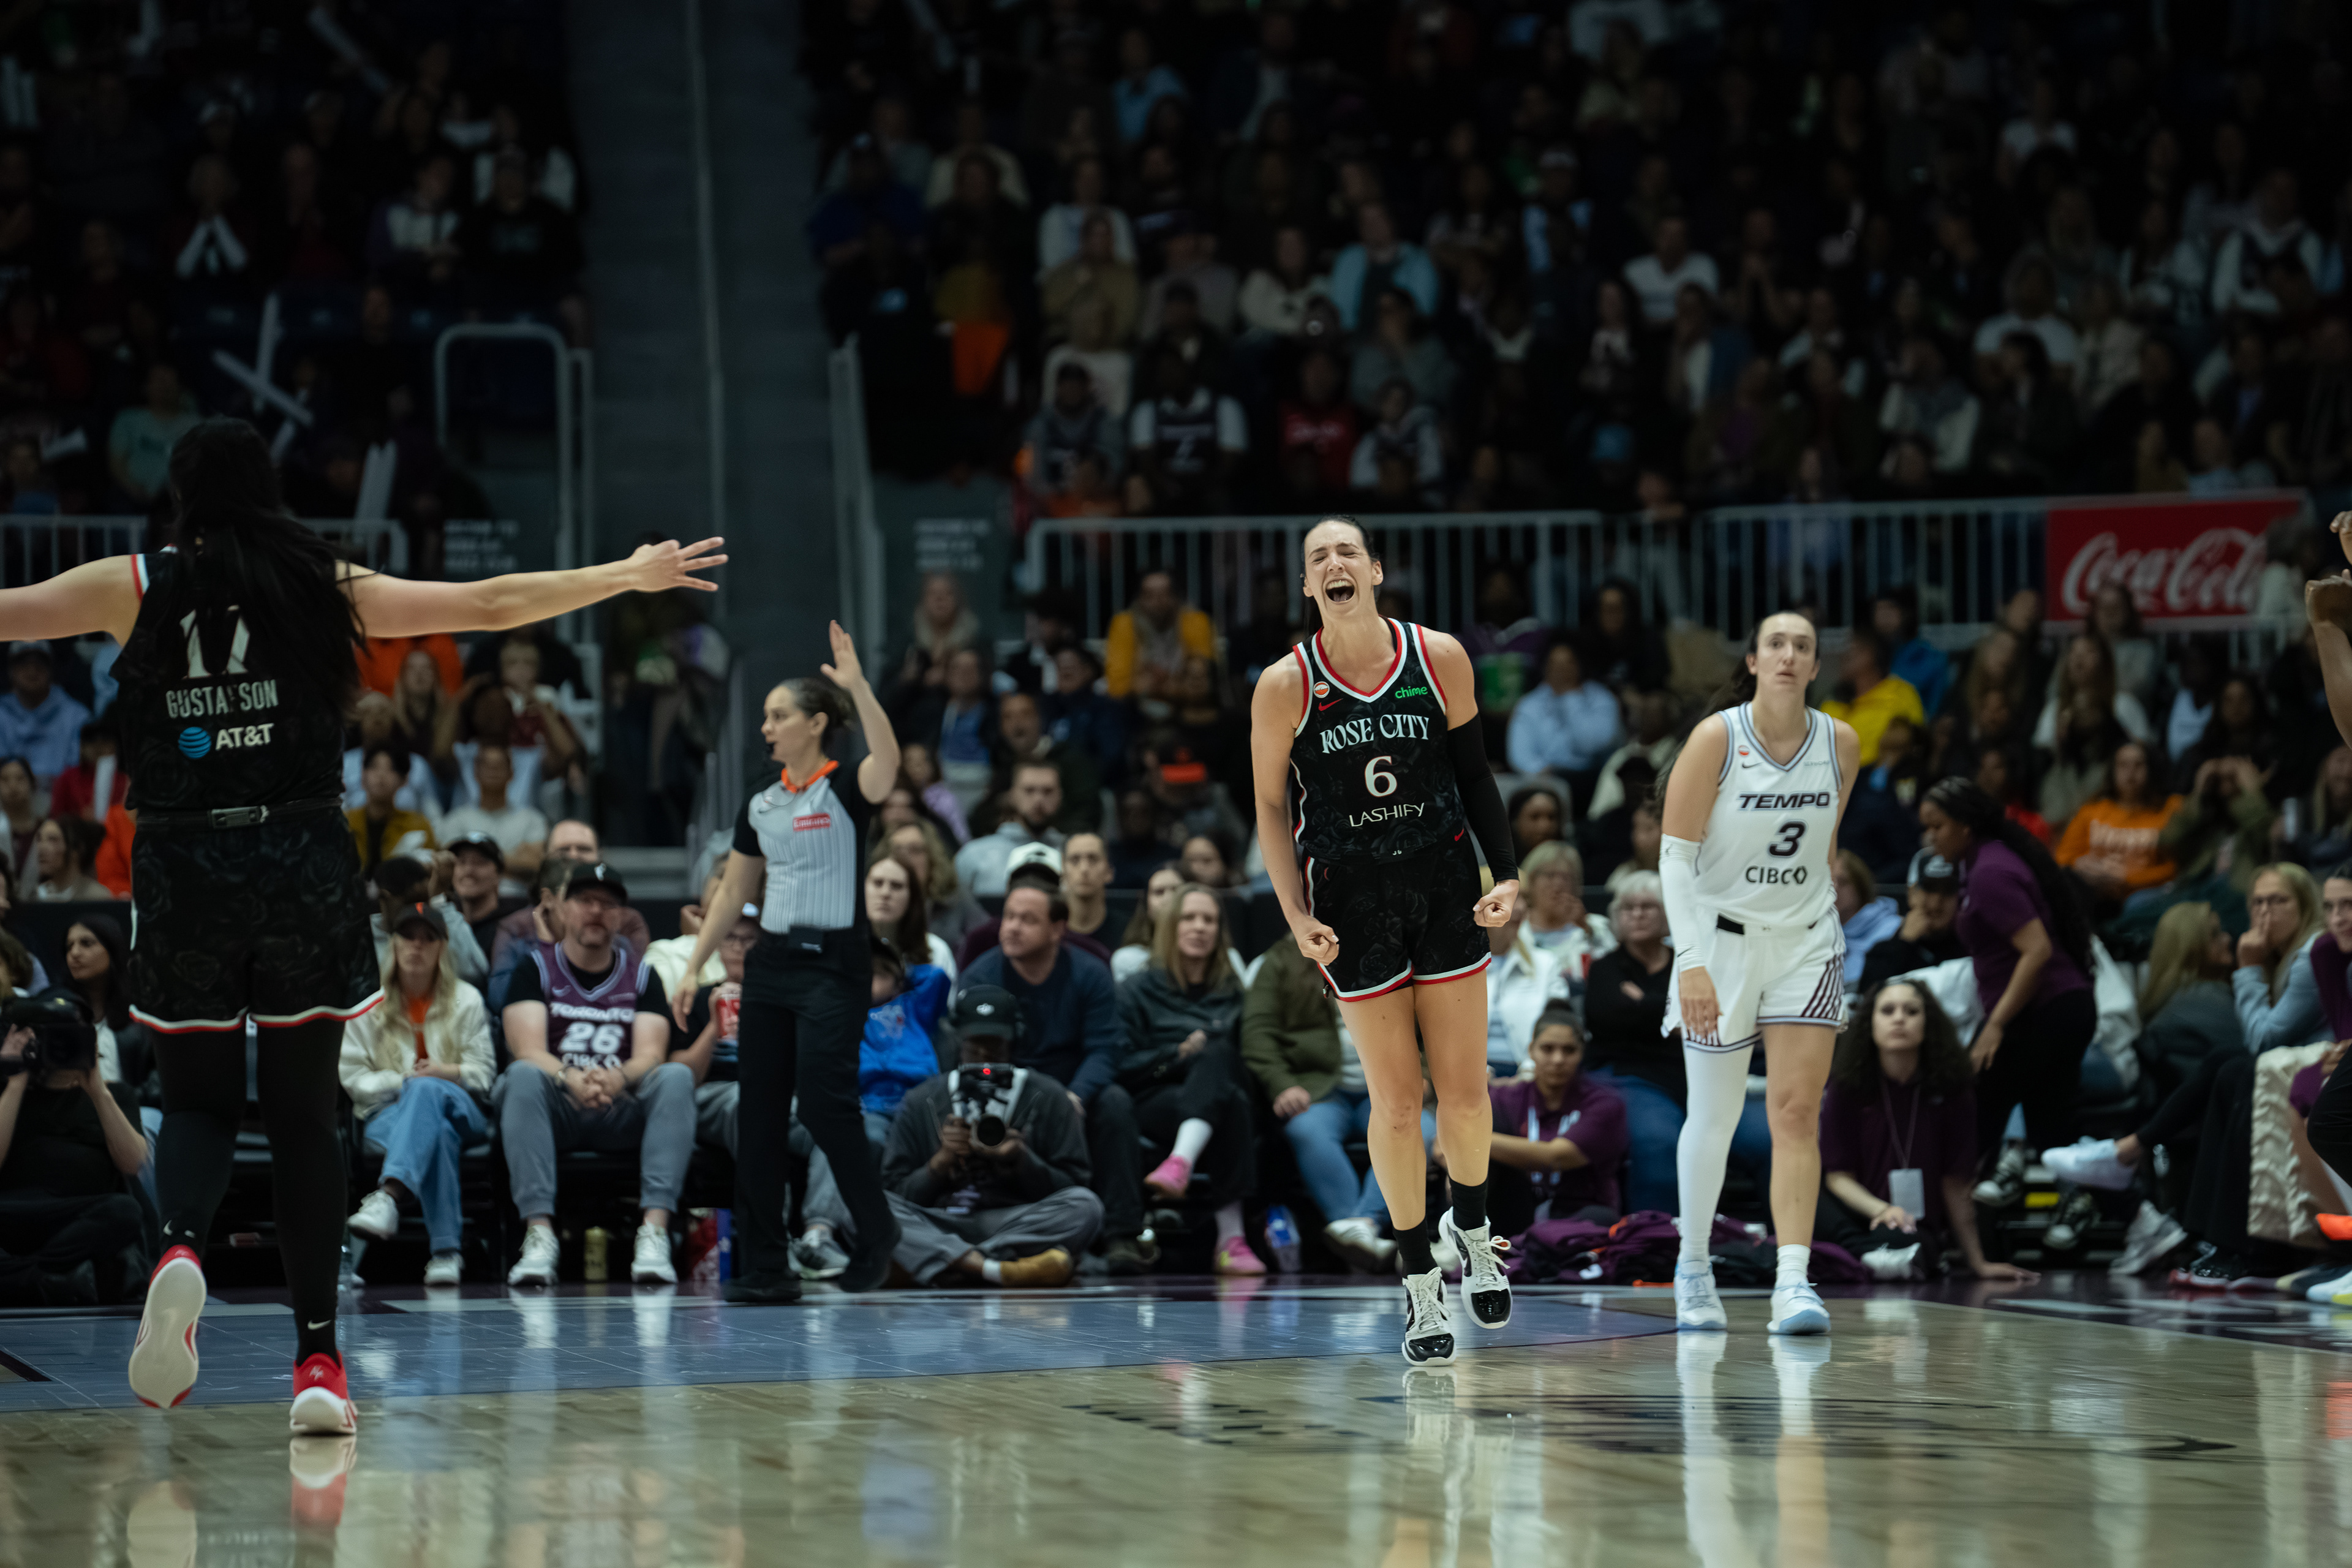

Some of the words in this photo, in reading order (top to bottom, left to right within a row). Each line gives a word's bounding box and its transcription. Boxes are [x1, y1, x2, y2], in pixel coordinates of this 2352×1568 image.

[1395, 685, 1428, 699] chime
[214, 722, 275, 751] AT&T
[1319, 717, 1374, 754] ROSE
[1379, 714, 1430, 741] CITY
[1364, 755, 1398, 797] 6
[1349, 802, 1425, 827] LASHIFY
[1738, 791, 1831, 810] TEMPO
[1769, 821, 1806, 856] 3
[557, 1020, 625, 1054] 26
